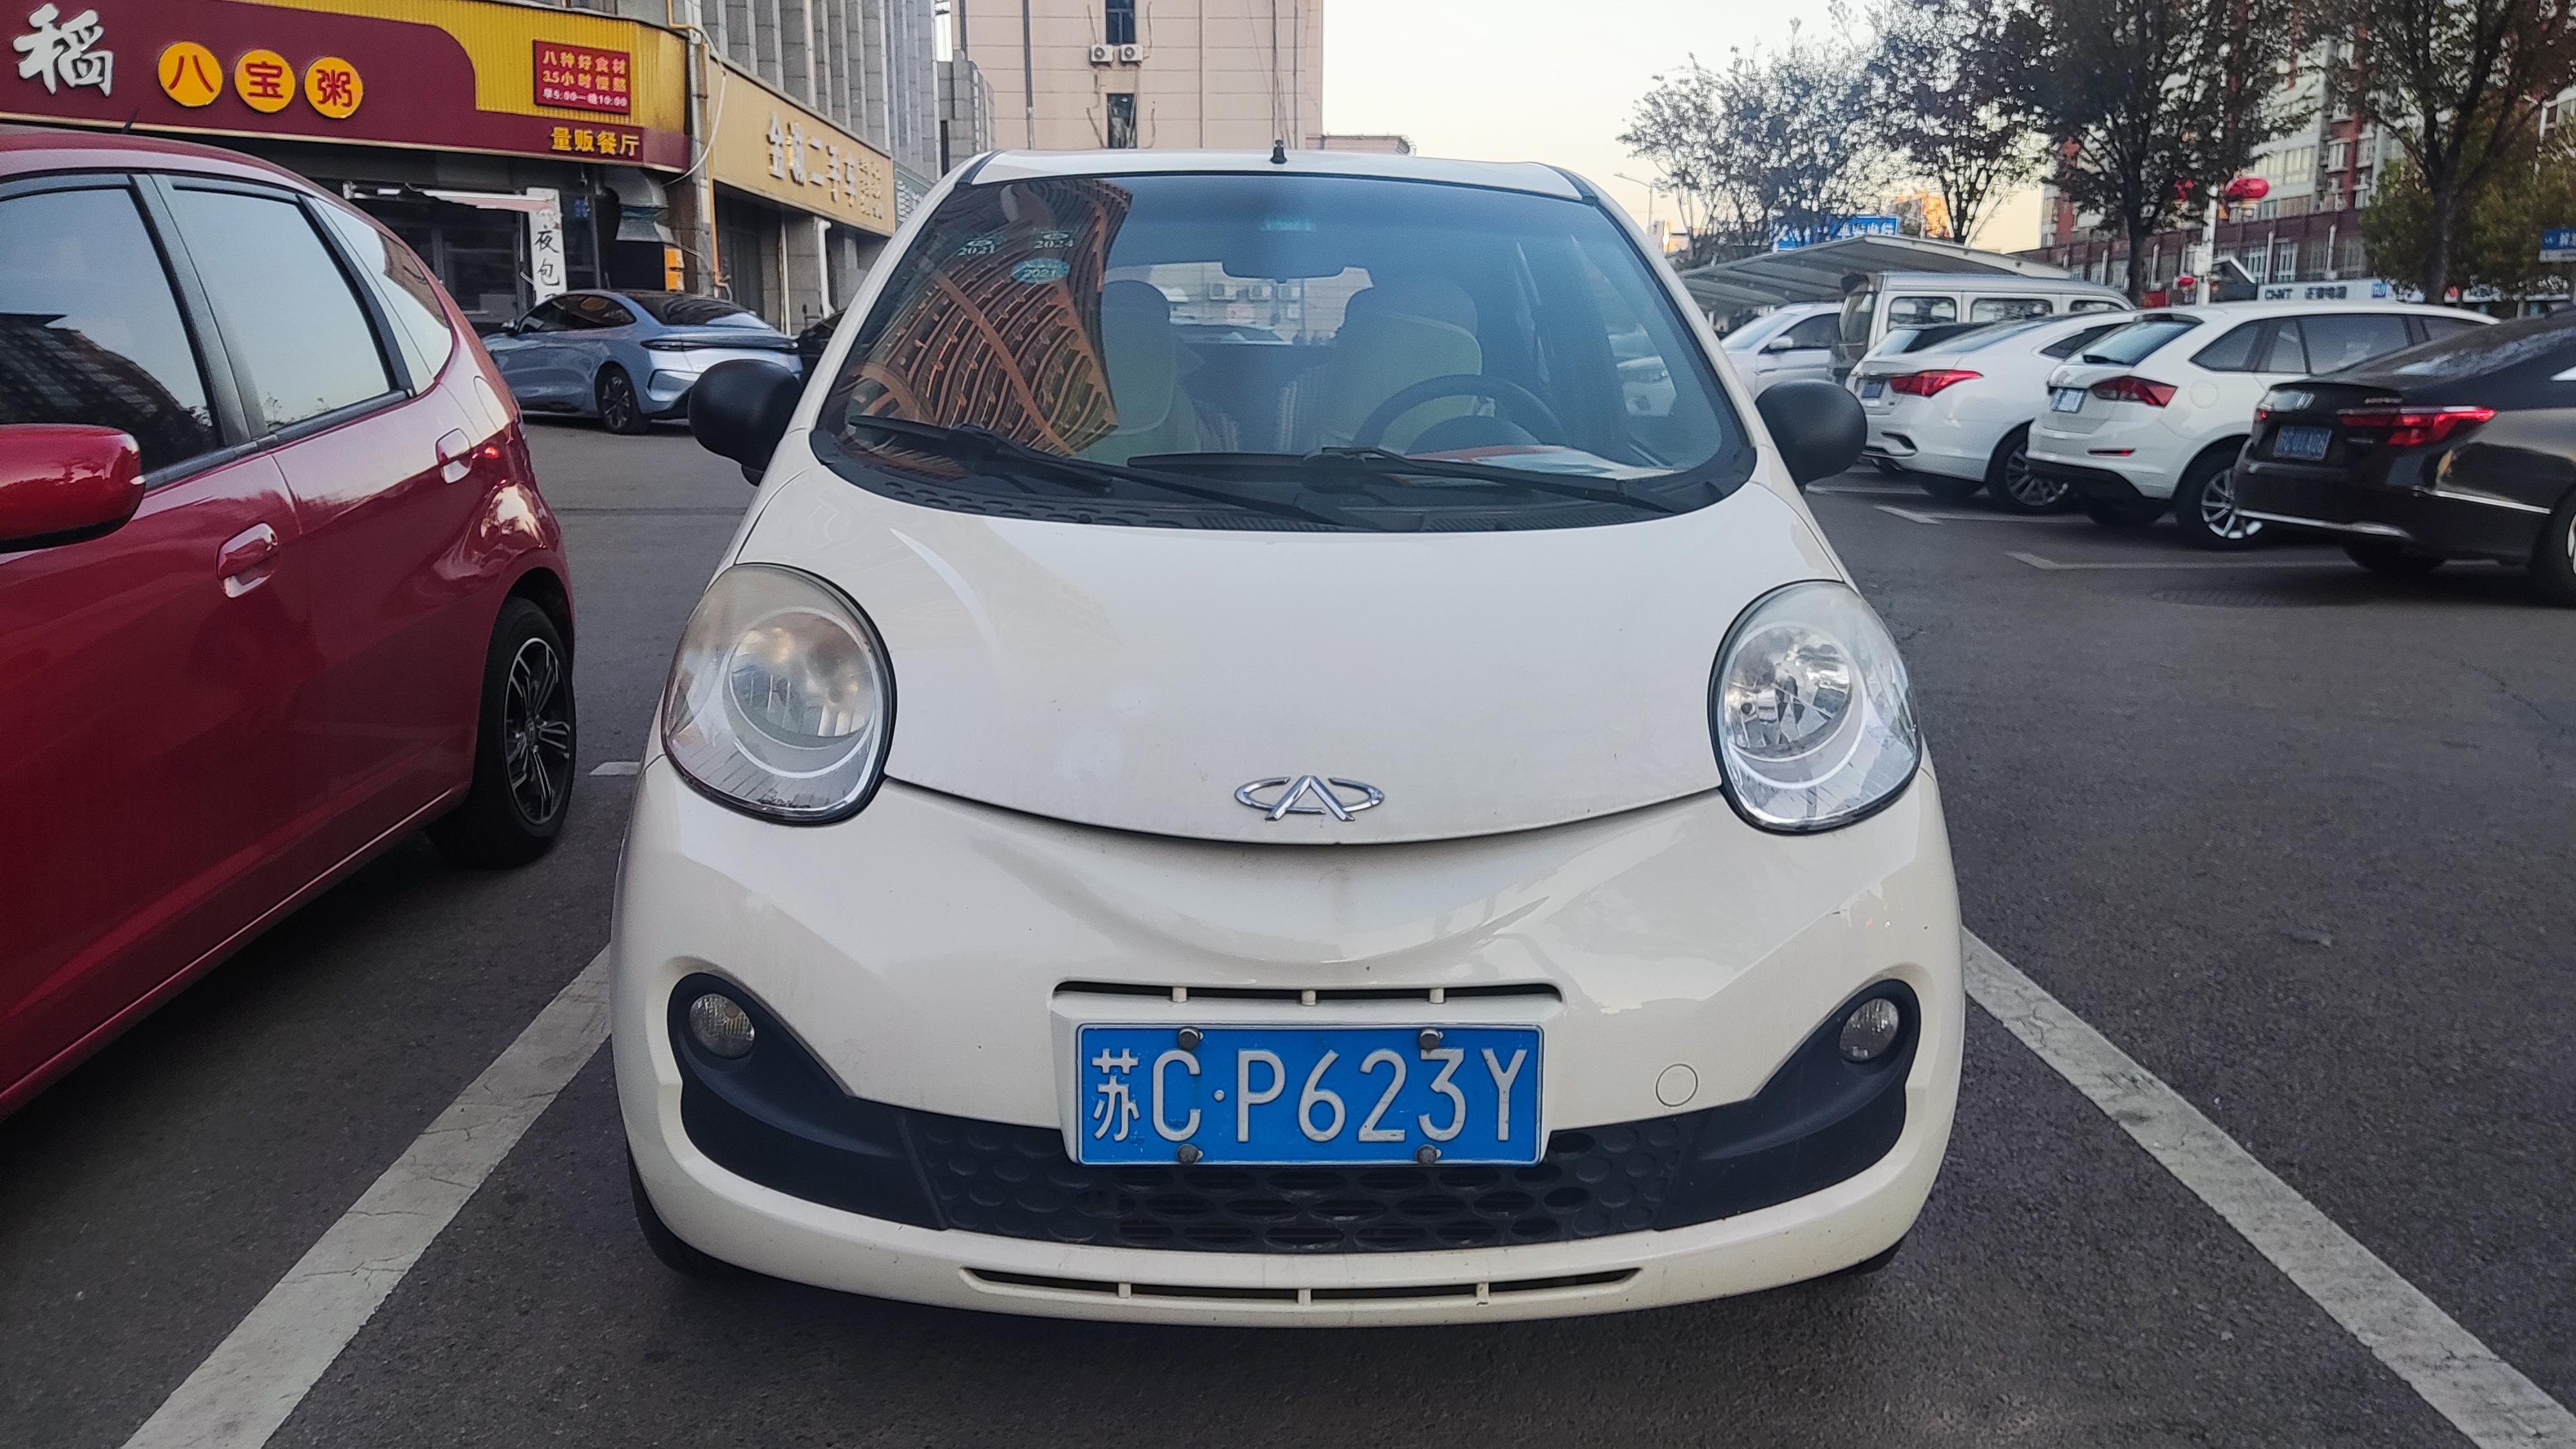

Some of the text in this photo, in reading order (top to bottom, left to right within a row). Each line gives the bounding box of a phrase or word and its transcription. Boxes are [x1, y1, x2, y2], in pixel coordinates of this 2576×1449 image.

[13, 3, 354, 108] 稻 八宝粥
[551, 127, 639, 156] 量贩餐厅
[533, 225, 560, 299] 夜包
[957, 243, 996, 256] 2021
[1034, 239, 1074, 249] 2024
[1092, 1048, 1528, 1142] 苏C·P623Y
